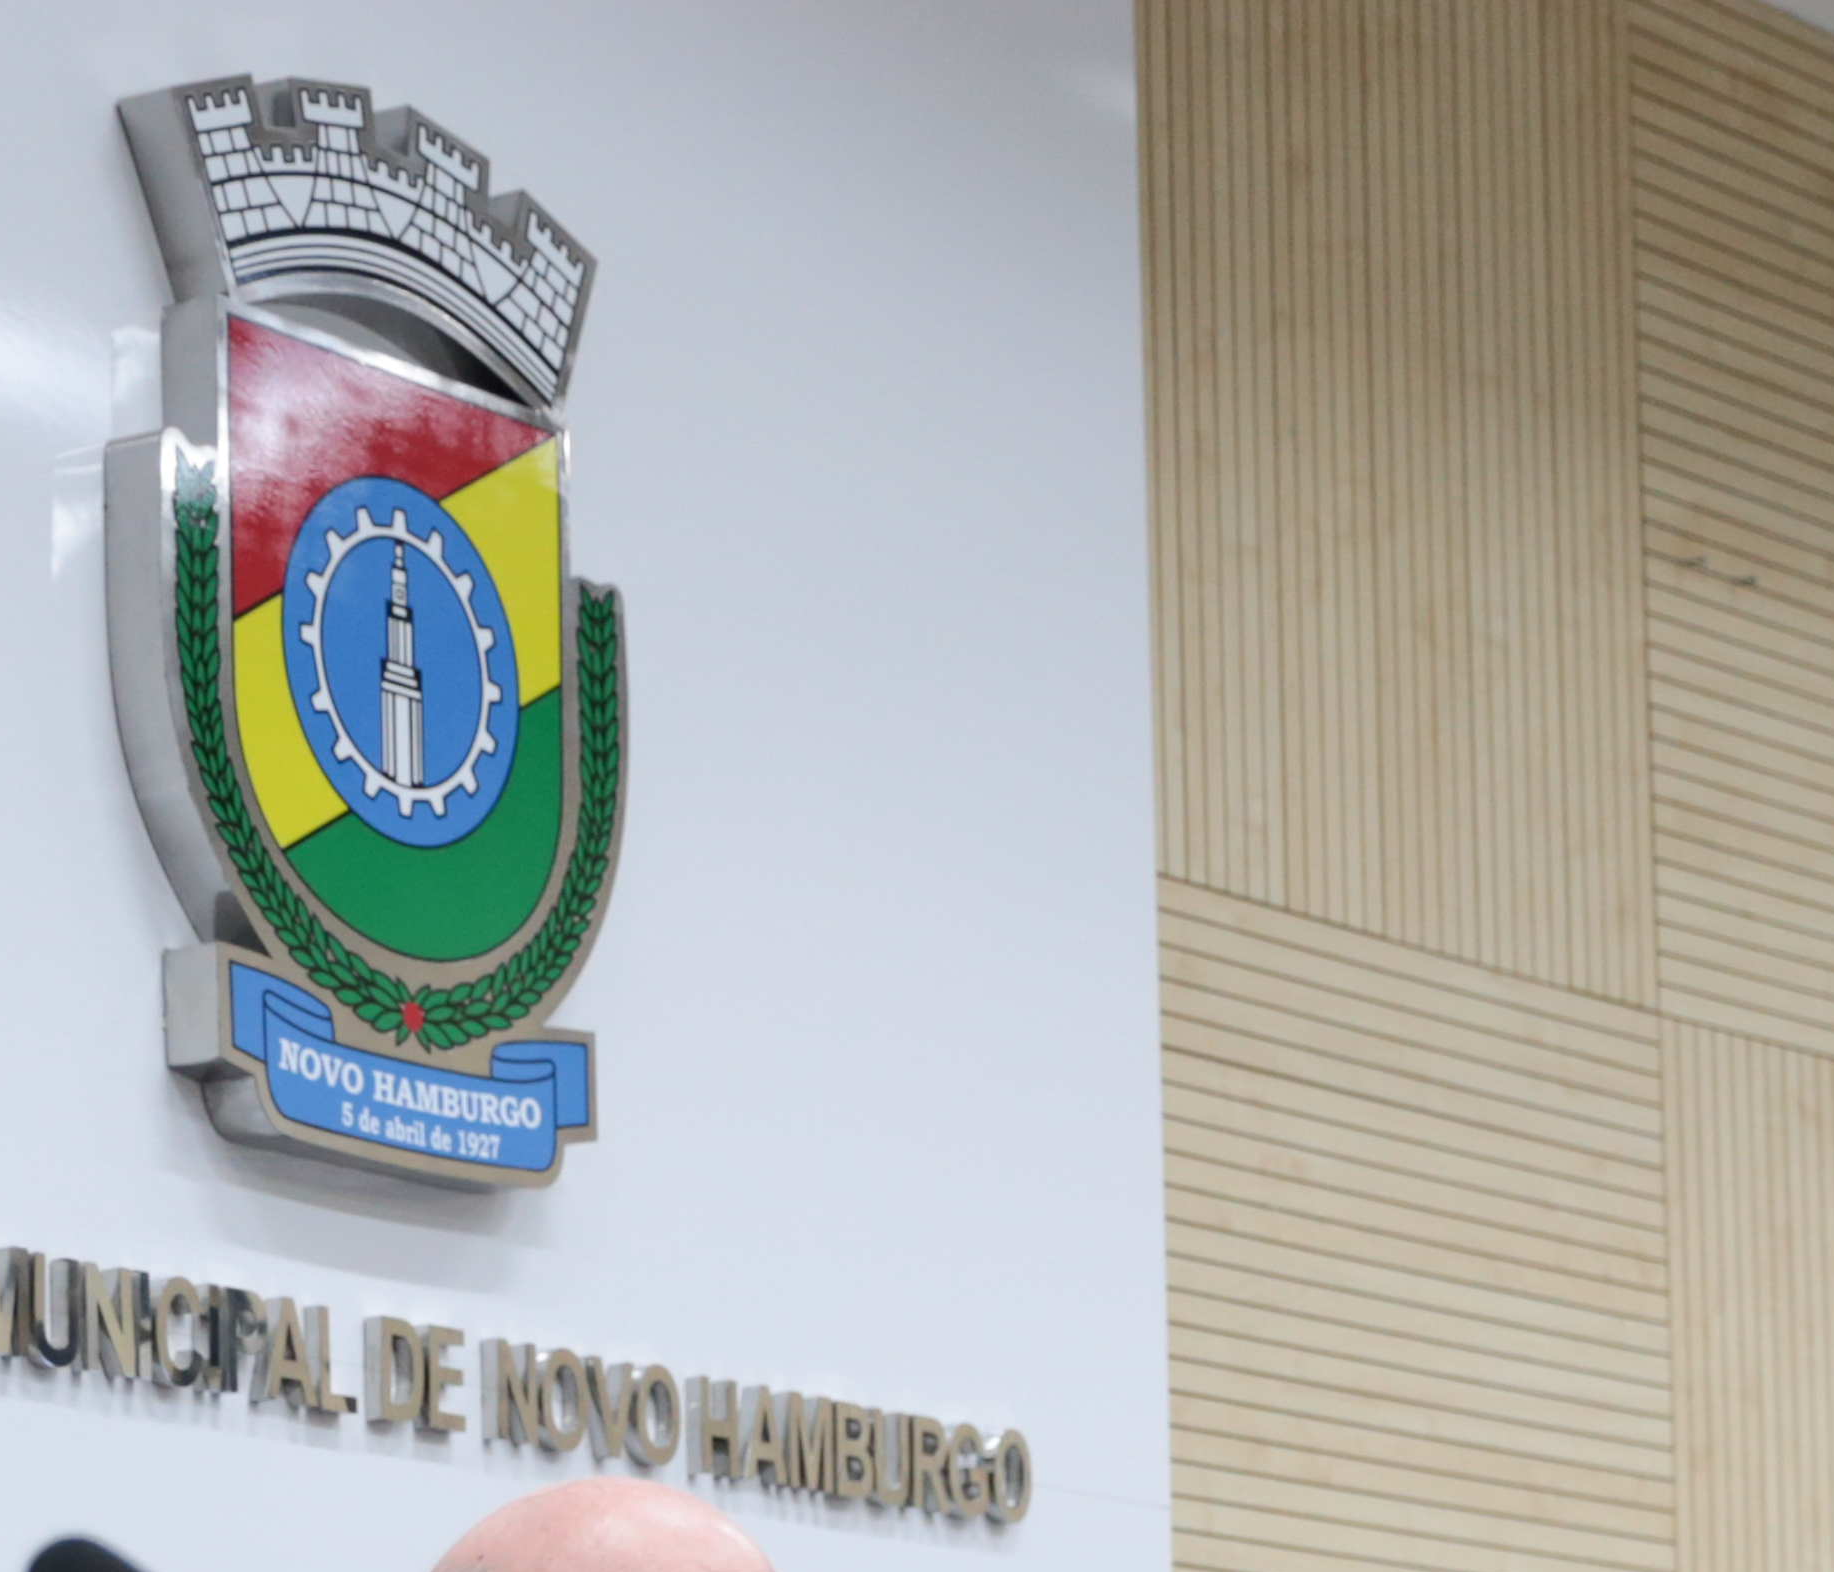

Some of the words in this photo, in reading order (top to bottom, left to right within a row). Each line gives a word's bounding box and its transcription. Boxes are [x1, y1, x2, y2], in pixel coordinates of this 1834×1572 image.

[279, 1037, 365, 1095] NOVO
[372, 1069, 542, 1130] HAMBURGO
[341, 1101, 354, 1128] 5
[357, 1107, 381, 1136] de
[384, 1115, 426, 1149] abril
[430, 1125, 453, 1153] de
[458, 1129, 502, 1160] 1927
[366, 1316, 466, 1433] DE
[481, 1338, 681, 1467] NOVO
[686, 1375, 1032, 1525] HAMBURGO
